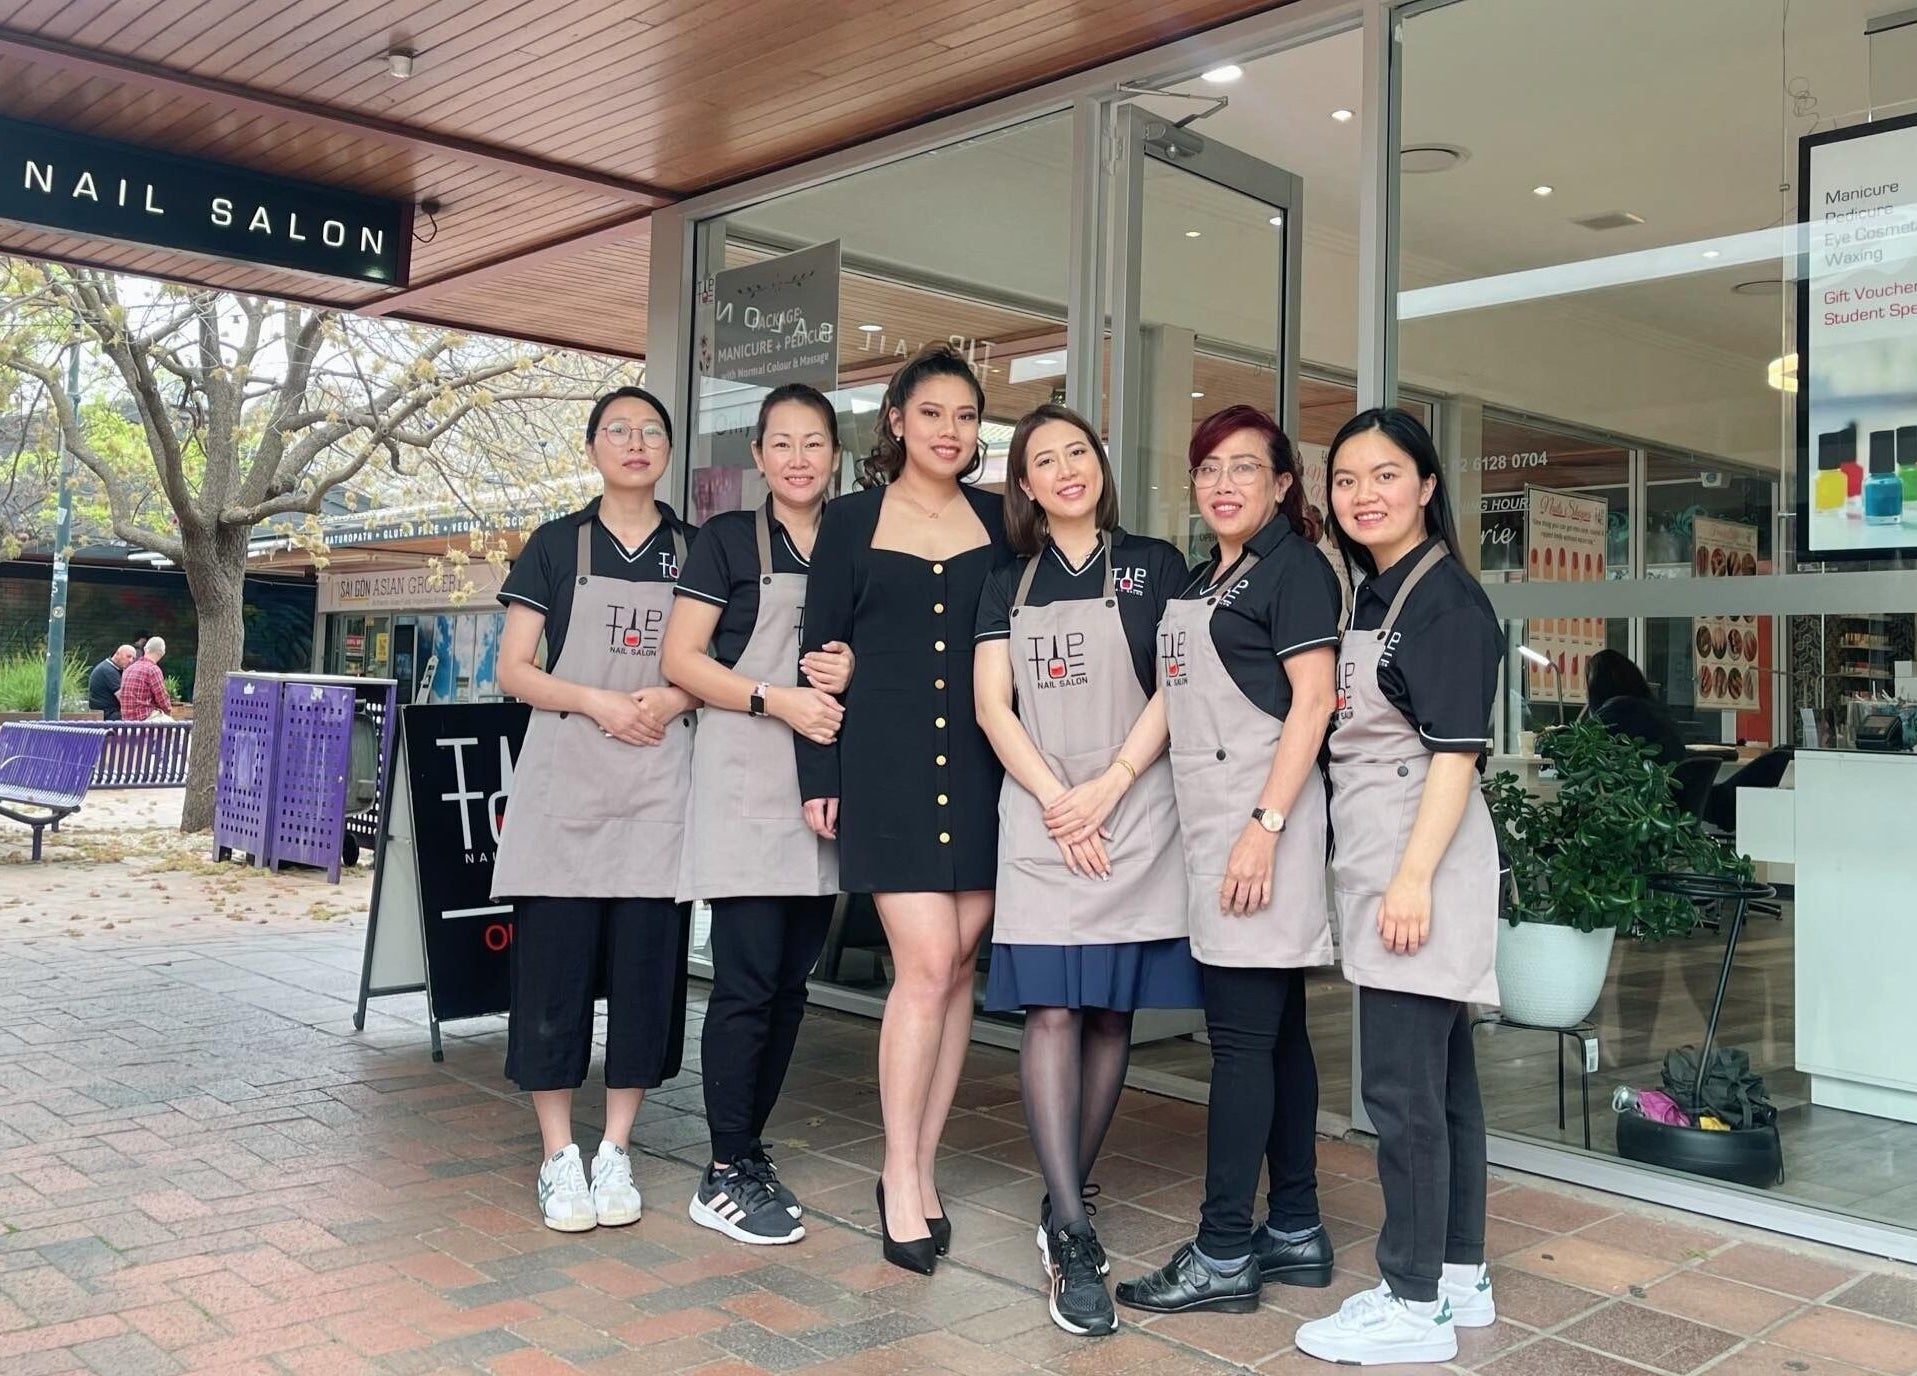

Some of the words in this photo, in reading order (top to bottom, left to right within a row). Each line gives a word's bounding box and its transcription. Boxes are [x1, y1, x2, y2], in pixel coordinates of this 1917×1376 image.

[1825, 182, 1899, 205] Manicure
[24, 160, 164, 214] NAIL
[211, 198, 383, 255] SALON
[1825, 204, 1894, 225] Pedicure
[1824, 231, 1850, 248] Eye
[1825, 248, 1883, 267] Waxing
[1824, 290, 1850, 305] Gift
[1824, 306, 1885, 326] Student
[718, 339, 773, 362] MANICURE
[766, 360, 791, 373] Colour
[799, 351, 829, 365] Massage
[1473, 454, 1507, 471] 6128
[1511, 450, 1549, 468] 0704
[1491, 497, 1531, 511] HOUR
[325, 532, 372, 545] NATUROPATH
[373, 577, 405, 596] ASIAN
[610, 646, 627, 655] NAIL
[631, 648, 656, 657] SALON
[1037, 679, 1057, 690] NAIL
[1059, 676, 1089, 688] SALON
[465, 851, 497, 864] NAI
